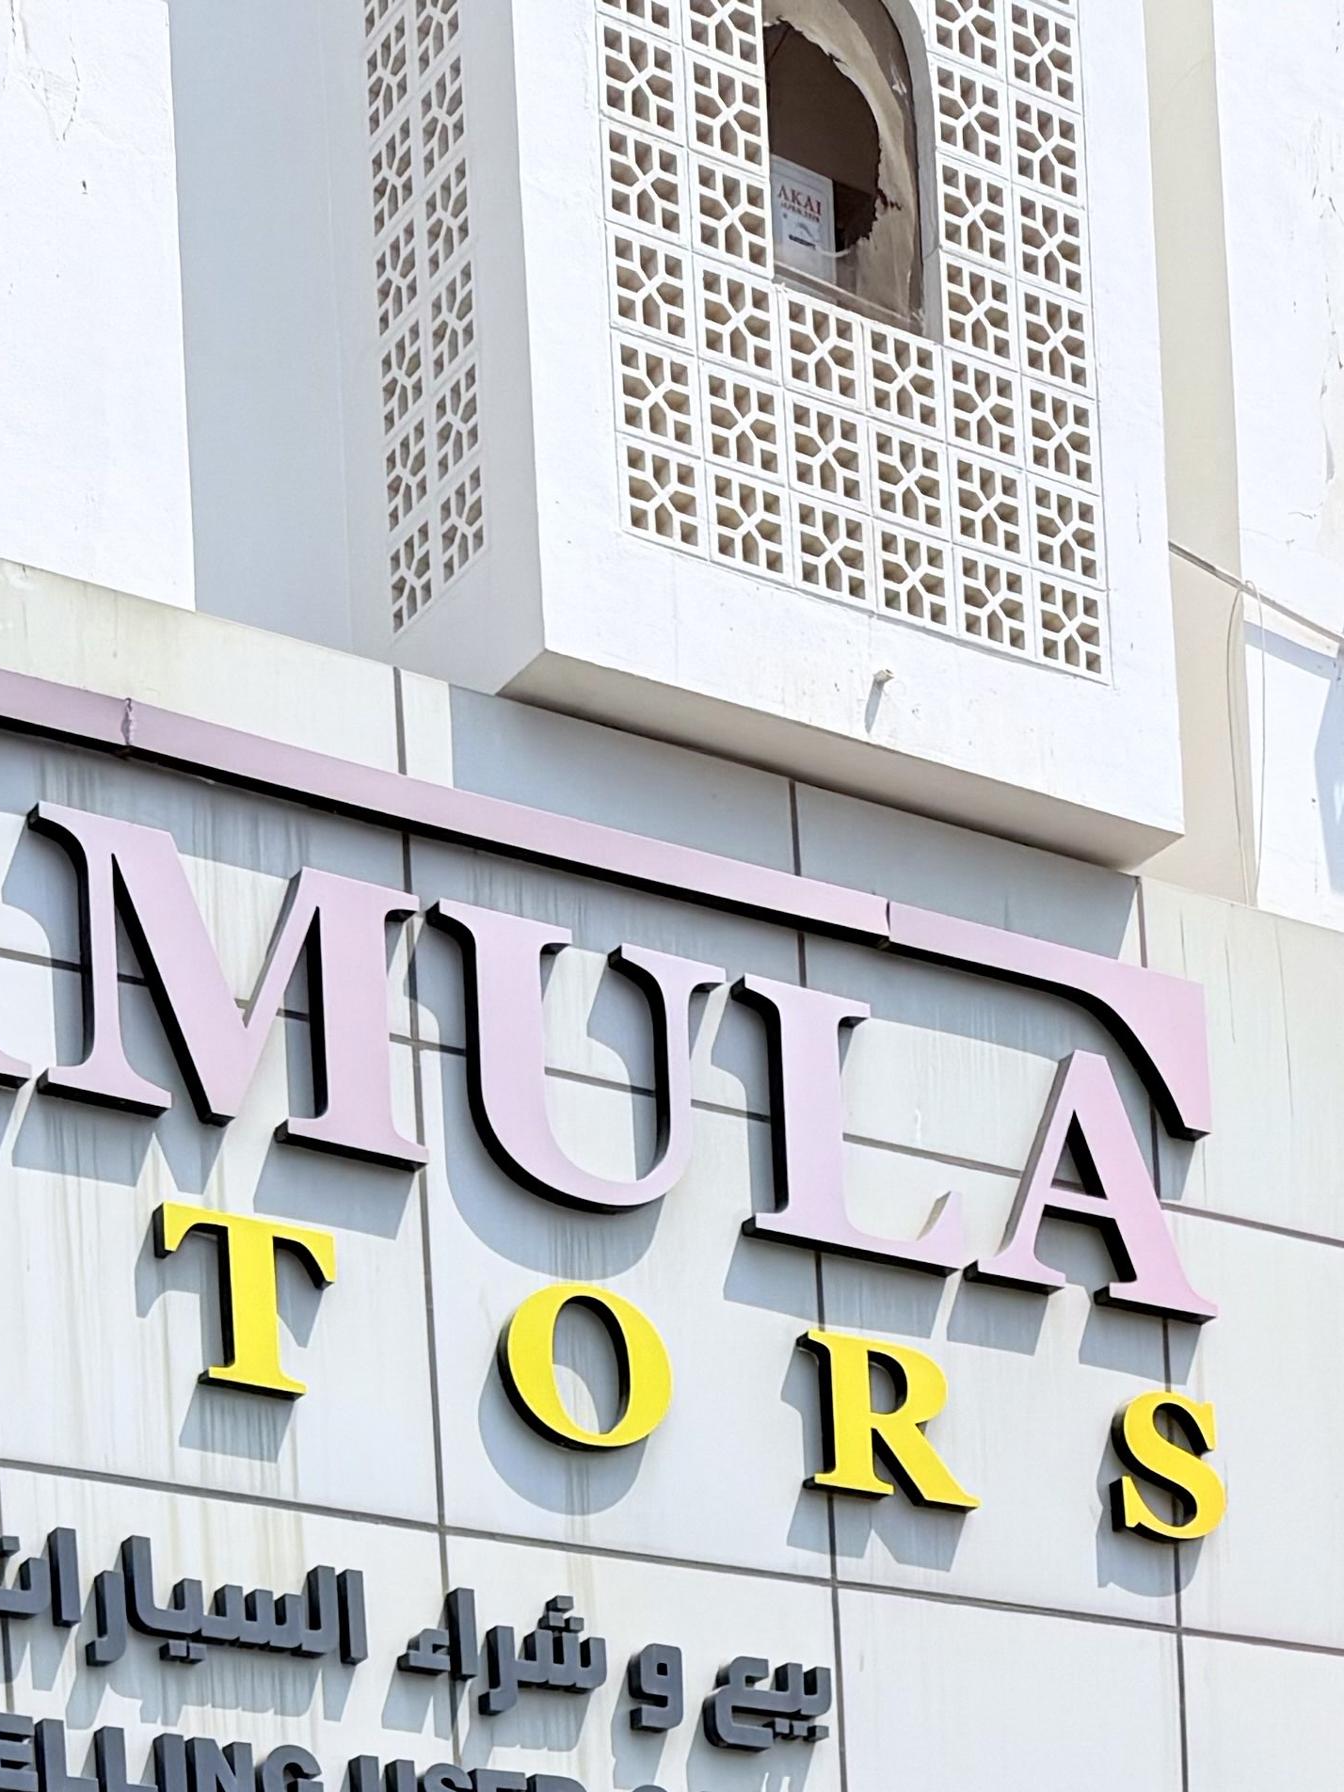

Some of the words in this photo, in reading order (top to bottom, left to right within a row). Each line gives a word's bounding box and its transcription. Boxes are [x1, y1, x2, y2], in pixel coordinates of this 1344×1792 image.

[398, 1588, 607, 1716] شراء
[628, 1643, 683, 1732] و
[703, 1655, 832, 1752] بيع
